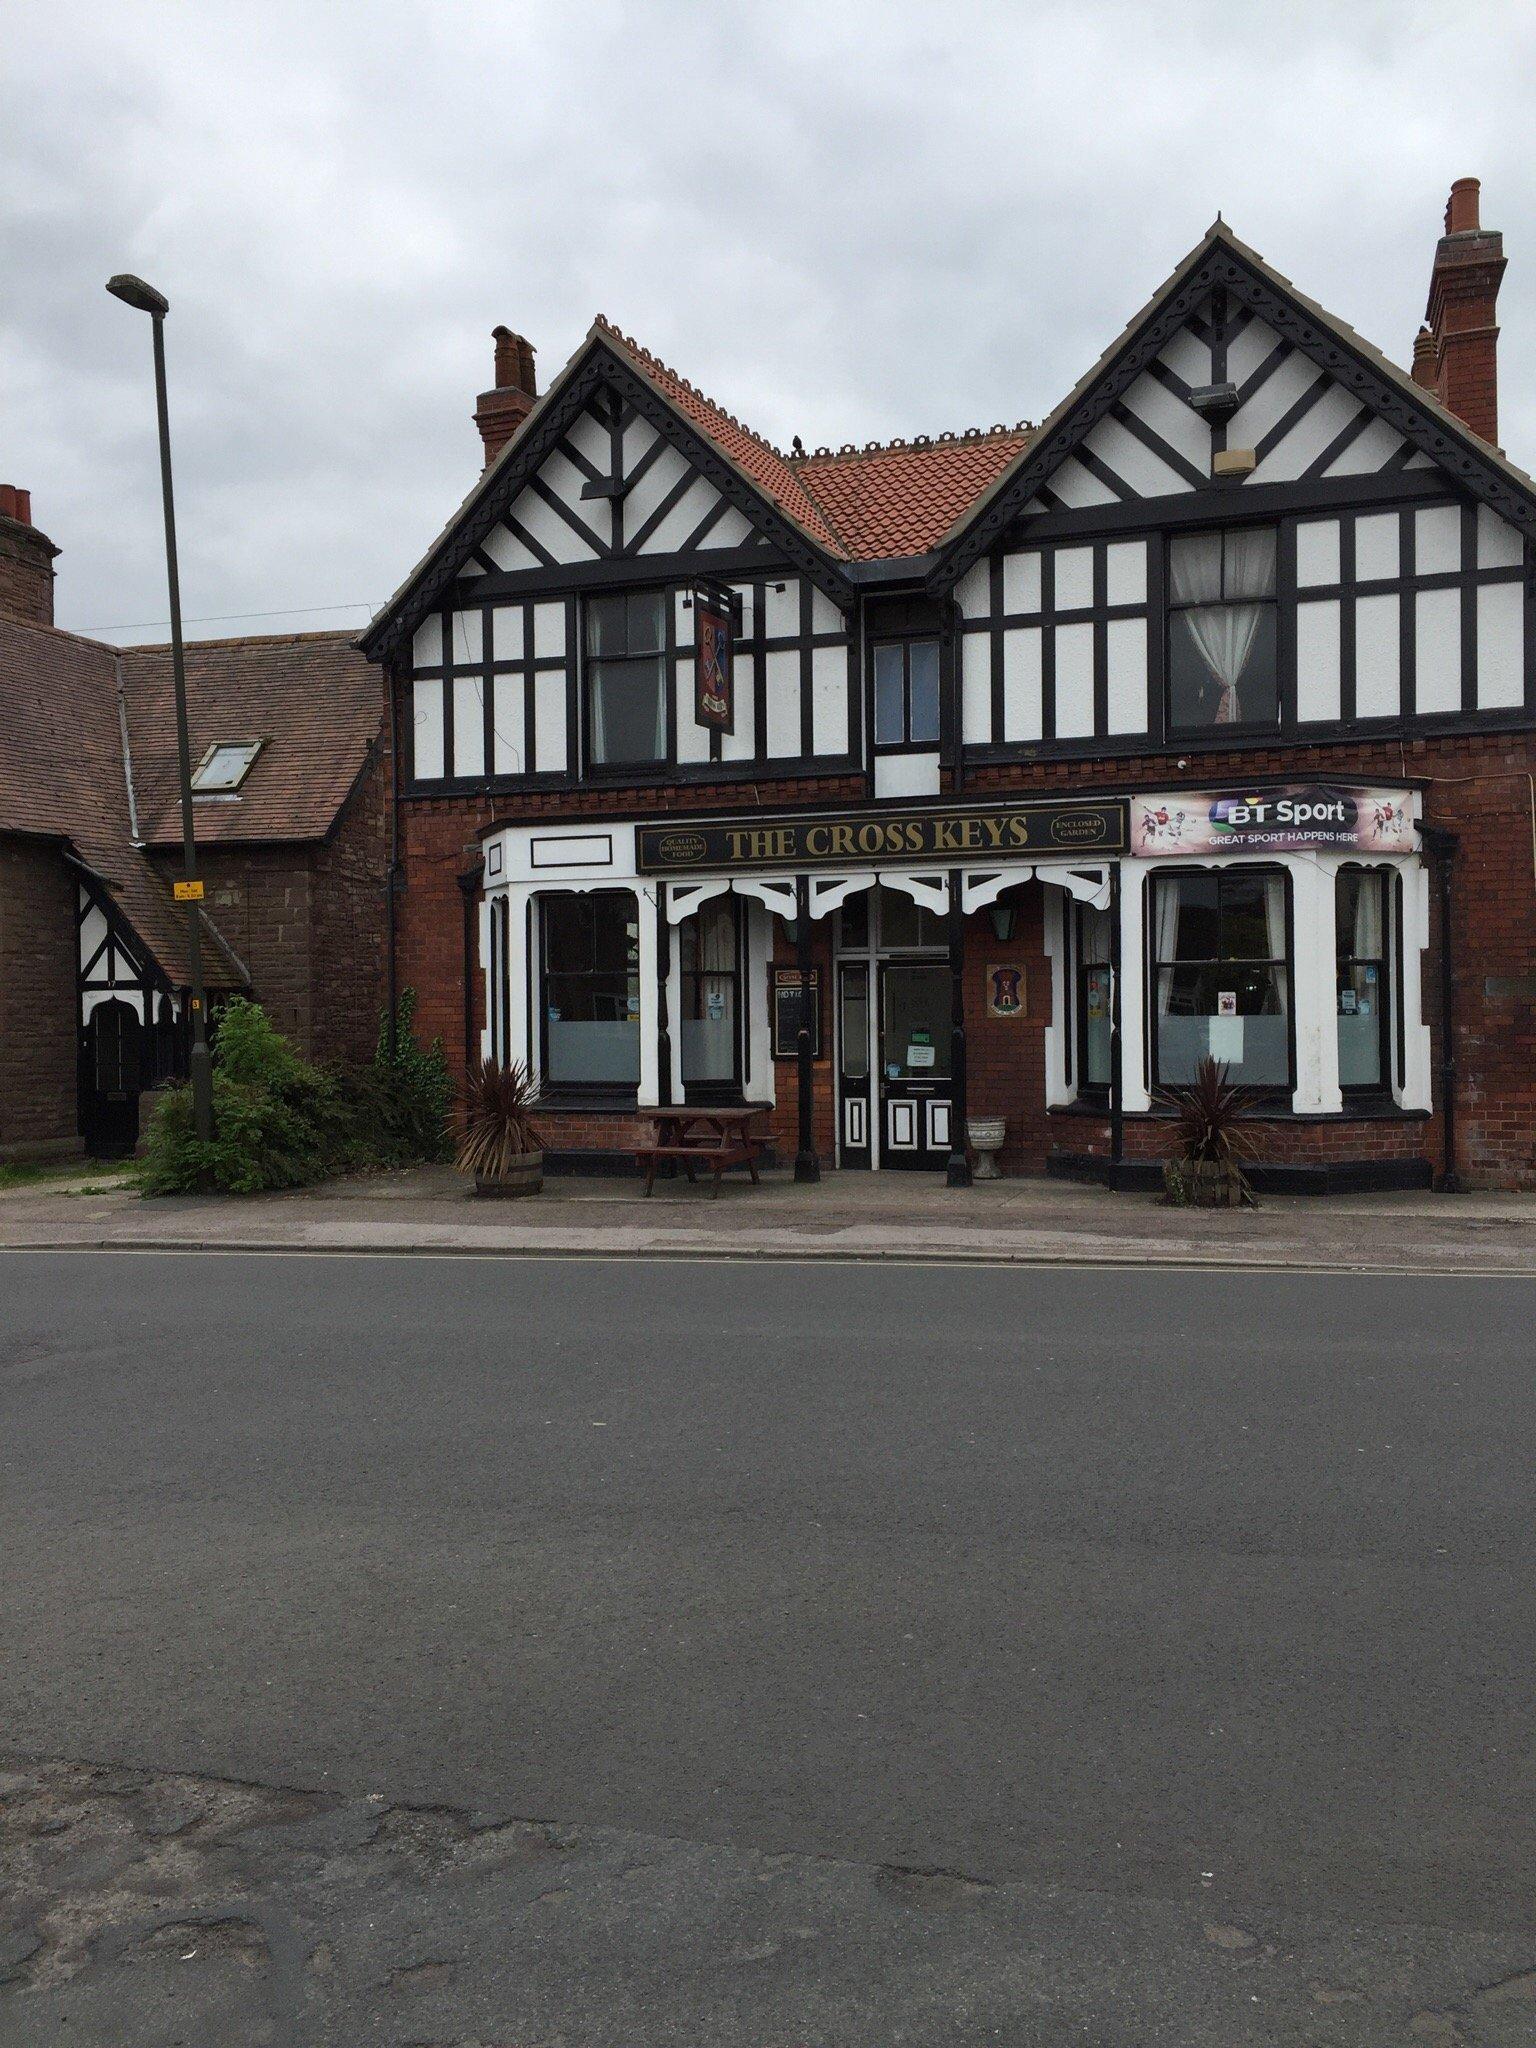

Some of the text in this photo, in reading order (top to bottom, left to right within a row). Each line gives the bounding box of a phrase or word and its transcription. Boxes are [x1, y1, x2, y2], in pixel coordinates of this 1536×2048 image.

[1228, 800, 1345, 825] BT Sport
[1056, 820, 1101, 829] ENCLOSED
[1060, 829, 1097, 837] GARDEN
[666, 838, 697, 846] QUALITY
[725, 816, 1028, 860] THE CROSS KEYS
[1209, 831, 1359, 845] GREAT SPORT HAPPENS HERE
[661, 844, 704, 852] HOMEMADE
[673, 850, 694, 858] FOOD
